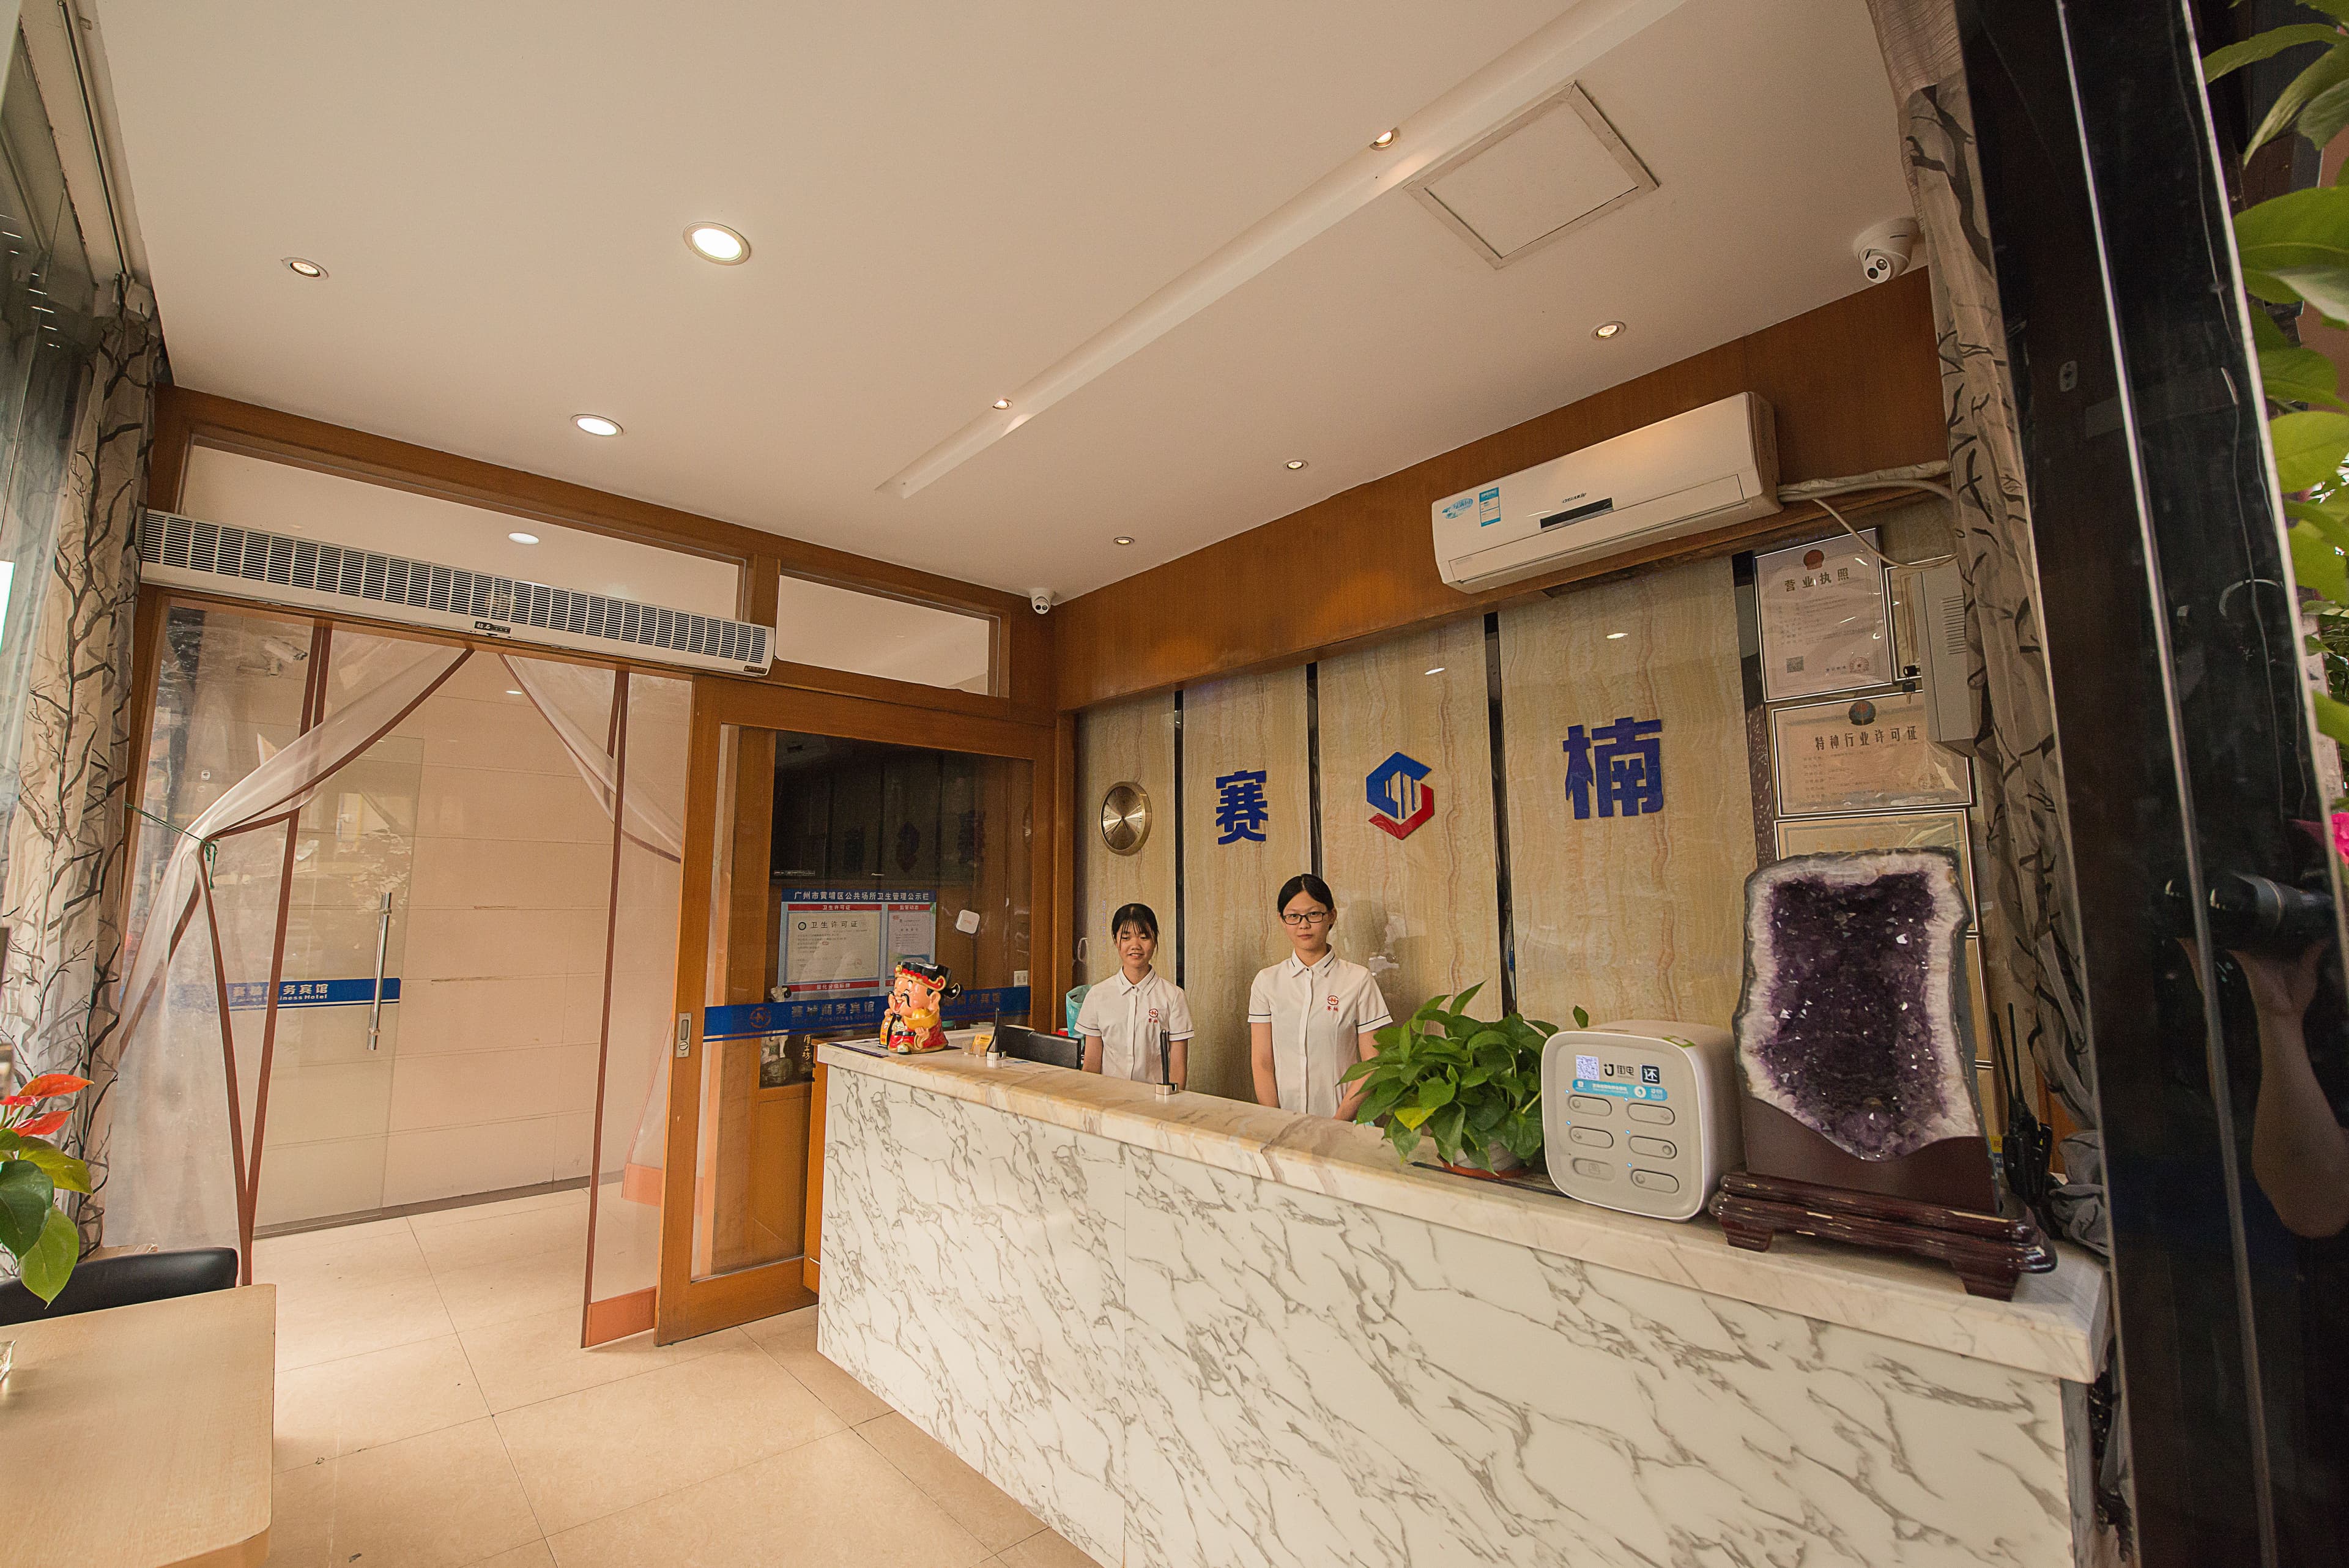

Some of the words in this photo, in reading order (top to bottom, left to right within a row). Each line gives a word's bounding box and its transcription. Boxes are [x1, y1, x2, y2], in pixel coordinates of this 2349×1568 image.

[1784, 567, 1849, 592] 营业执照
[1815, 726, 1917, 751] 特种行业许可证
[1215, 770, 1269, 845] 赛
[1562, 716, 1663, 821] 楠
[794, 891, 930, 901] 广州市黄埔区公共场所卫生管理公示栏
[811, 920, 858, 929] 卫生许可证
